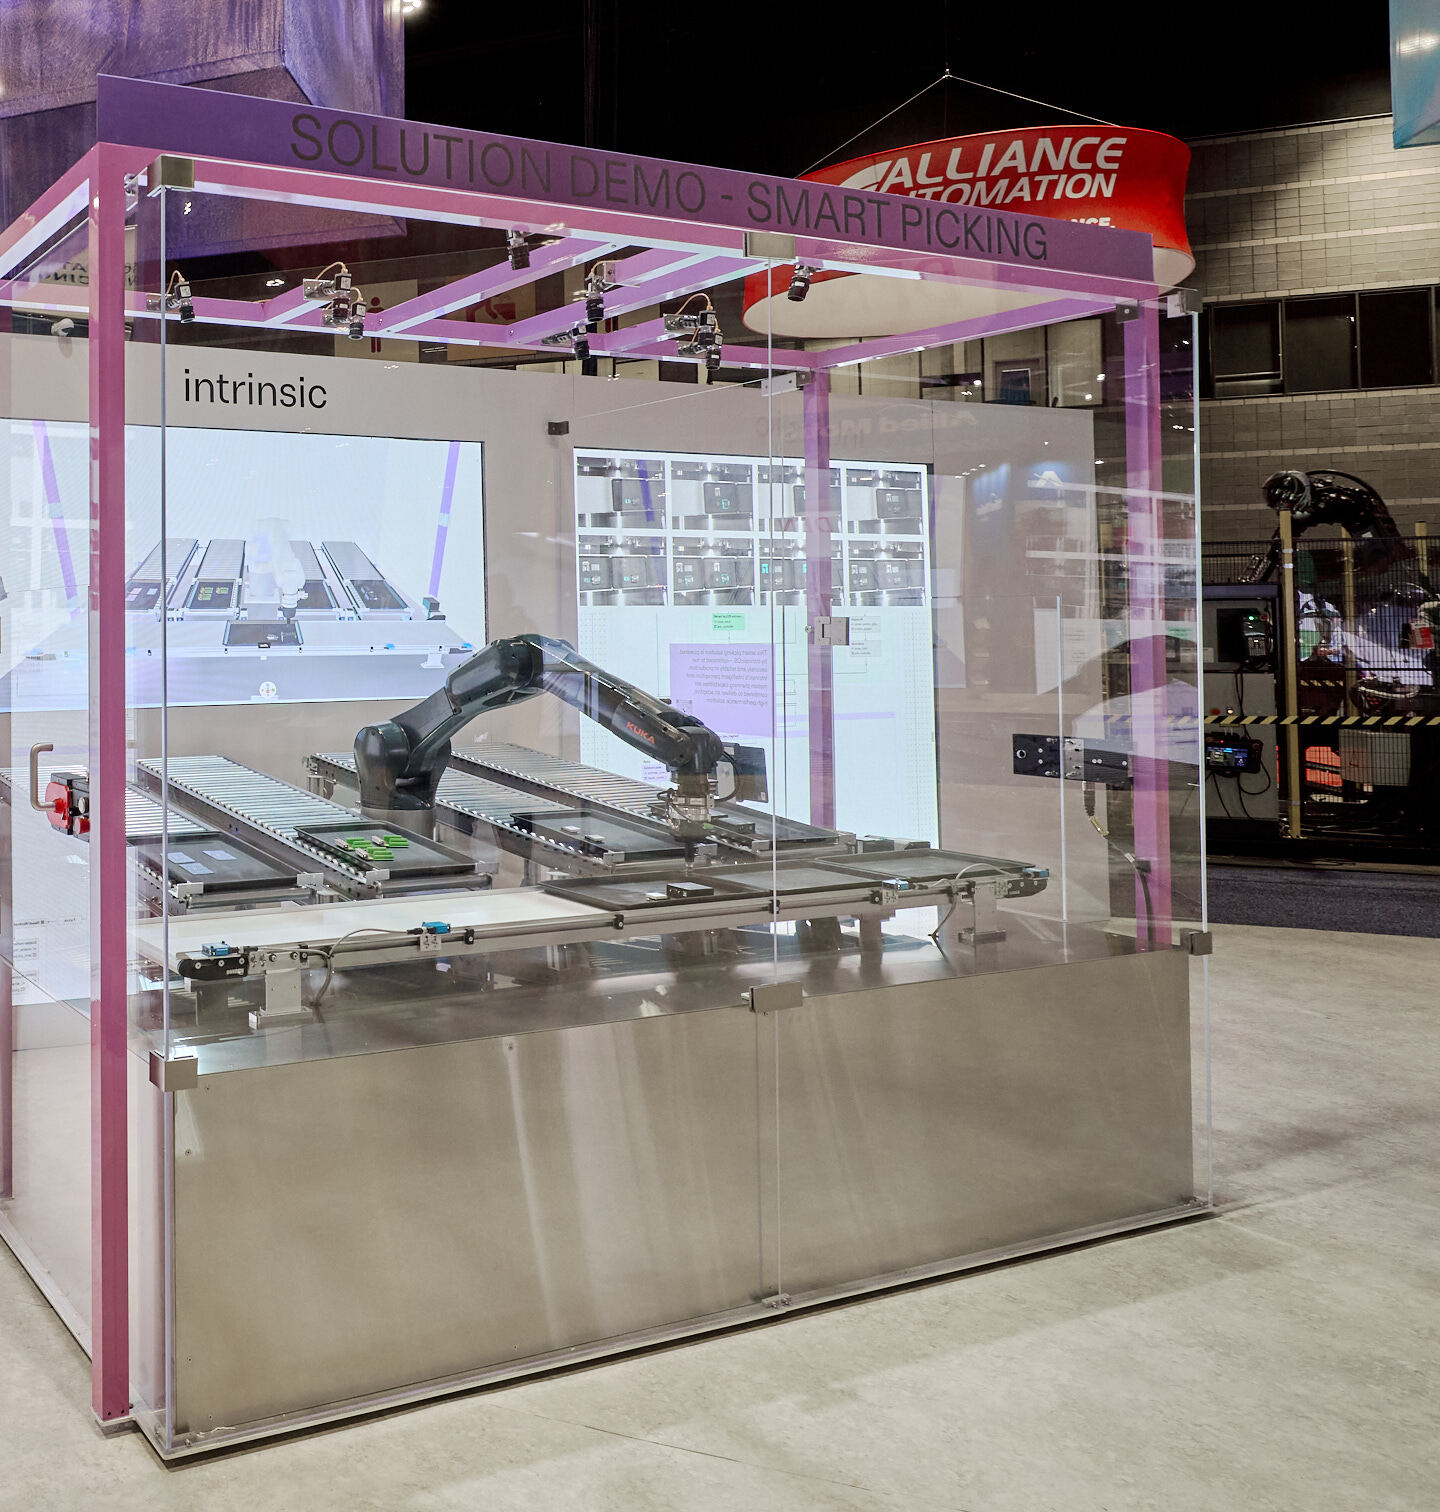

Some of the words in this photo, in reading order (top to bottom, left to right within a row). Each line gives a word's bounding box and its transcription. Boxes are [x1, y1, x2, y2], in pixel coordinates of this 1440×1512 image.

[874, 137, 1127, 193] ALLIANCE
[290, 113, 552, 193] SOLUTION
[570, 154, 706, 214] DEMO
[747, 181, 890, 239] SMART
[901, 203, 1048, 261] PICKING
[904, 173, 1118, 206] TOMATION
[185, 368, 327, 409] intrinsic
[625, 721, 655, 745] KUKA
